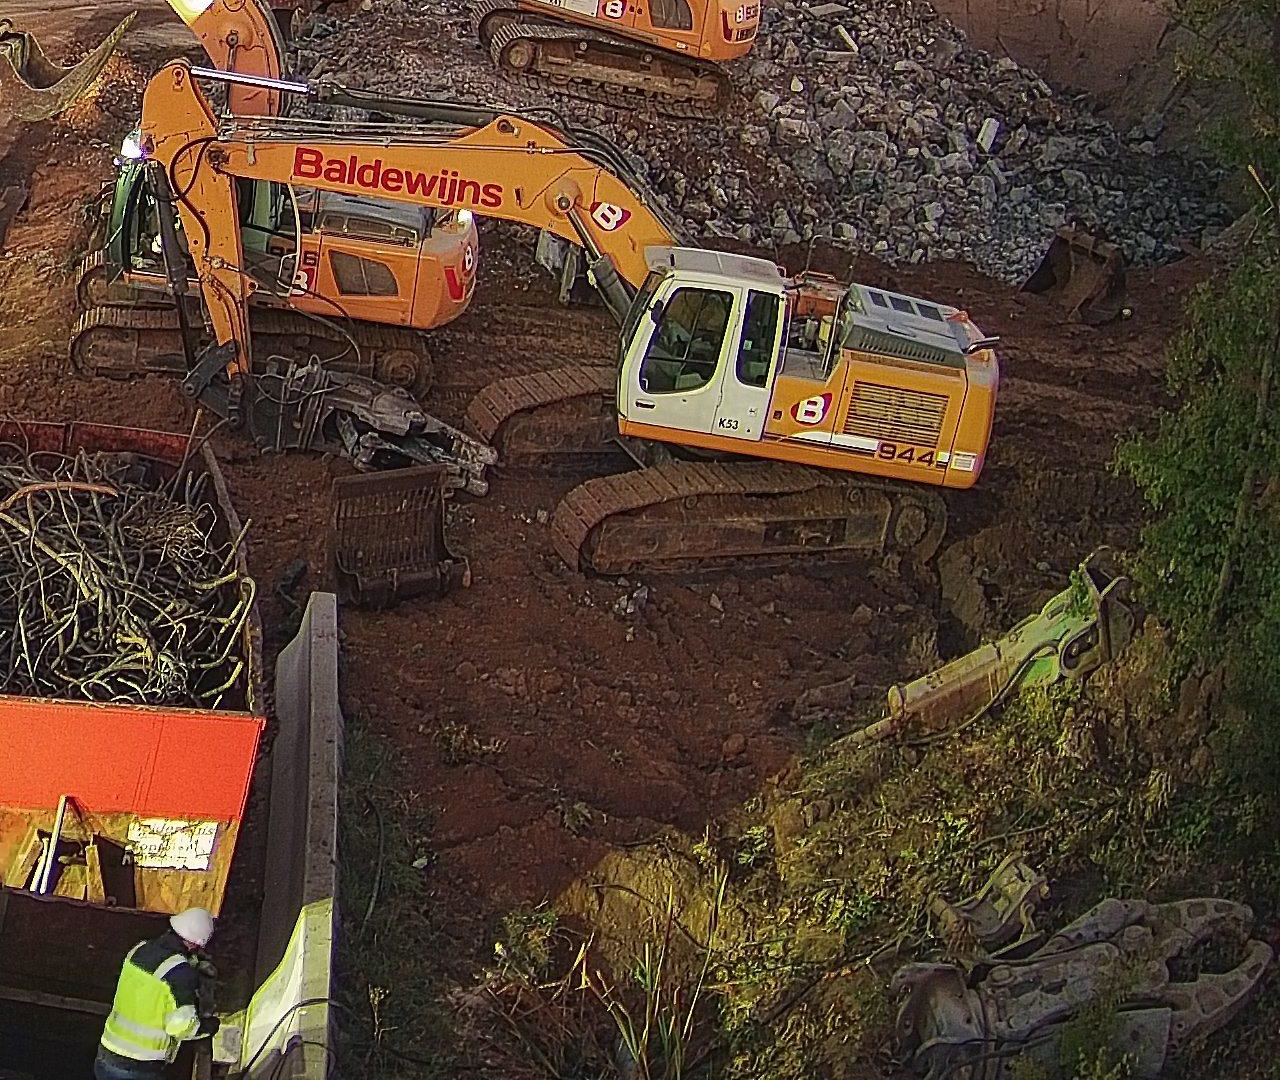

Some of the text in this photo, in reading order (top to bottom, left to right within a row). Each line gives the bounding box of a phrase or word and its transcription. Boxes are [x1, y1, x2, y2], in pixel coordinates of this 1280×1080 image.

[292, 146, 504, 208] Baldewijns
[718, 417, 739, 430] K53
[877, 443, 936, 467] 944
